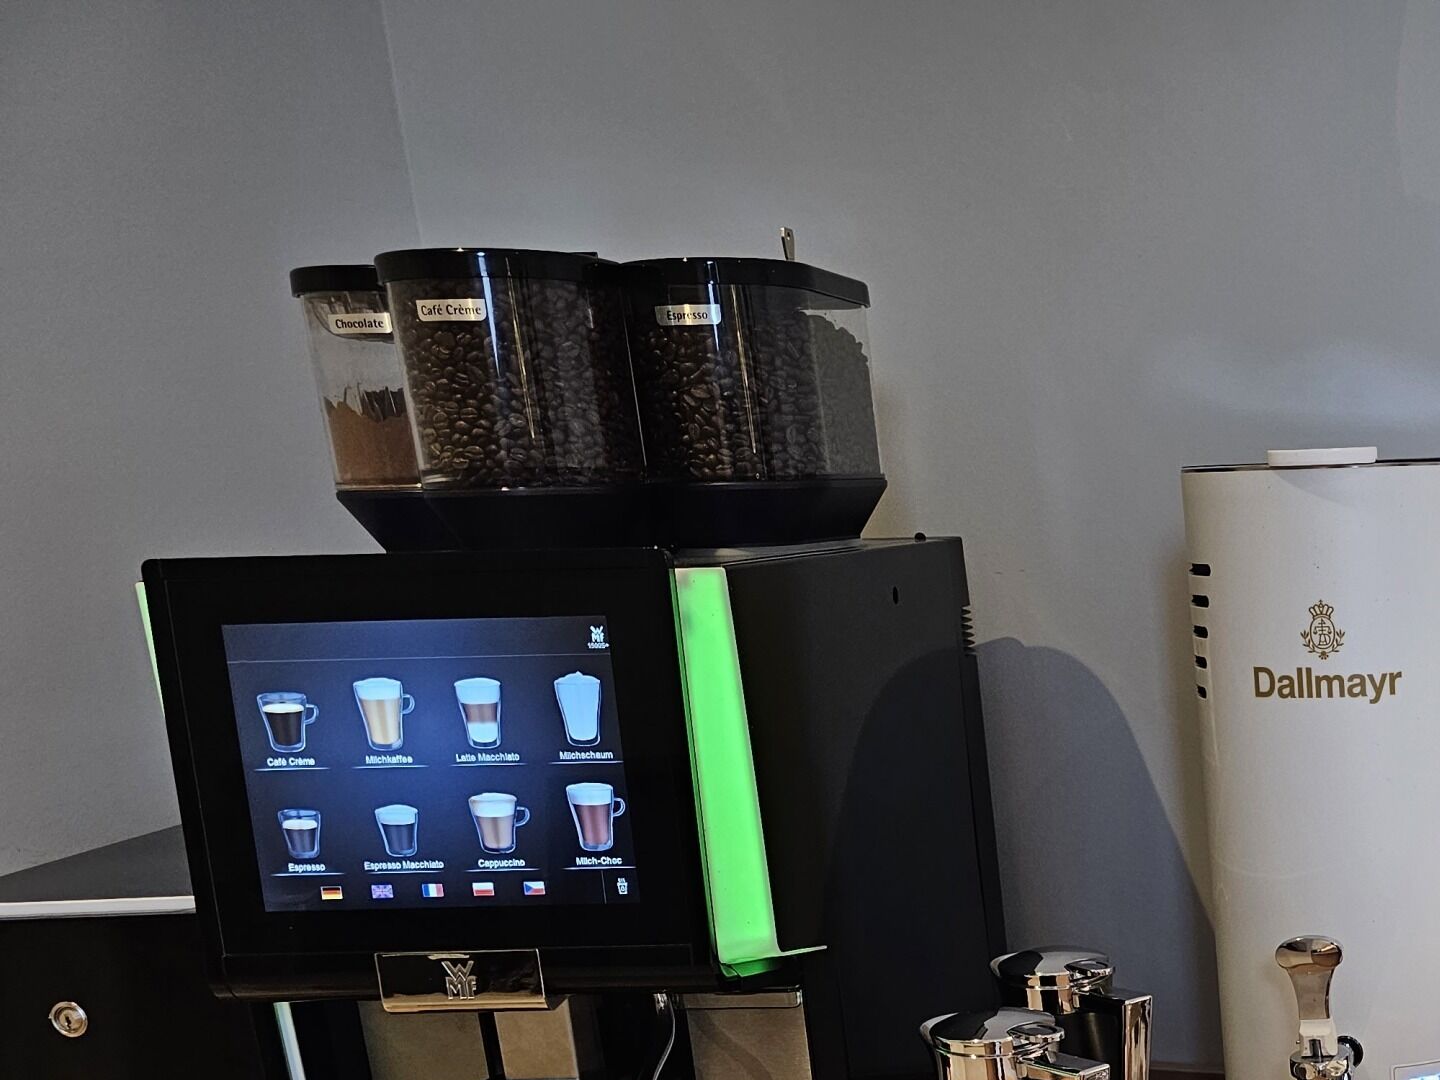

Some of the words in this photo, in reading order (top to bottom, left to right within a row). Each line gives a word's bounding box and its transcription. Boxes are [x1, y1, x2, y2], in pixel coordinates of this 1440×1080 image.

[421, 302, 443, 317] Café
[446, 302, 481, 316] Crème
[666, 309, 708, 322] Espresso
[335, 316, 384, 331] Chocolate
[1253, 667, 1402, 704] Dallmayr
[365, 755, 413, 764] Milchkaffee
[456, 753, 477, 762] Latte
[478, 752, 520, 761] Macchiato
[559, 750, 614, 760] Milchschaum
[267, 757, 286, 767] Café
[288, 757, 316, 766] Crème
[363, 861, 401, 871] Espresso
[402, 860, 444, 869] Macchiato
[478, 858, 526, 869] Cappuccino
[576, 857, 623, 866] Milch-Choc
[288, 862, 326, 873] Espresso
[441, 960, 477, 1000] WMF
